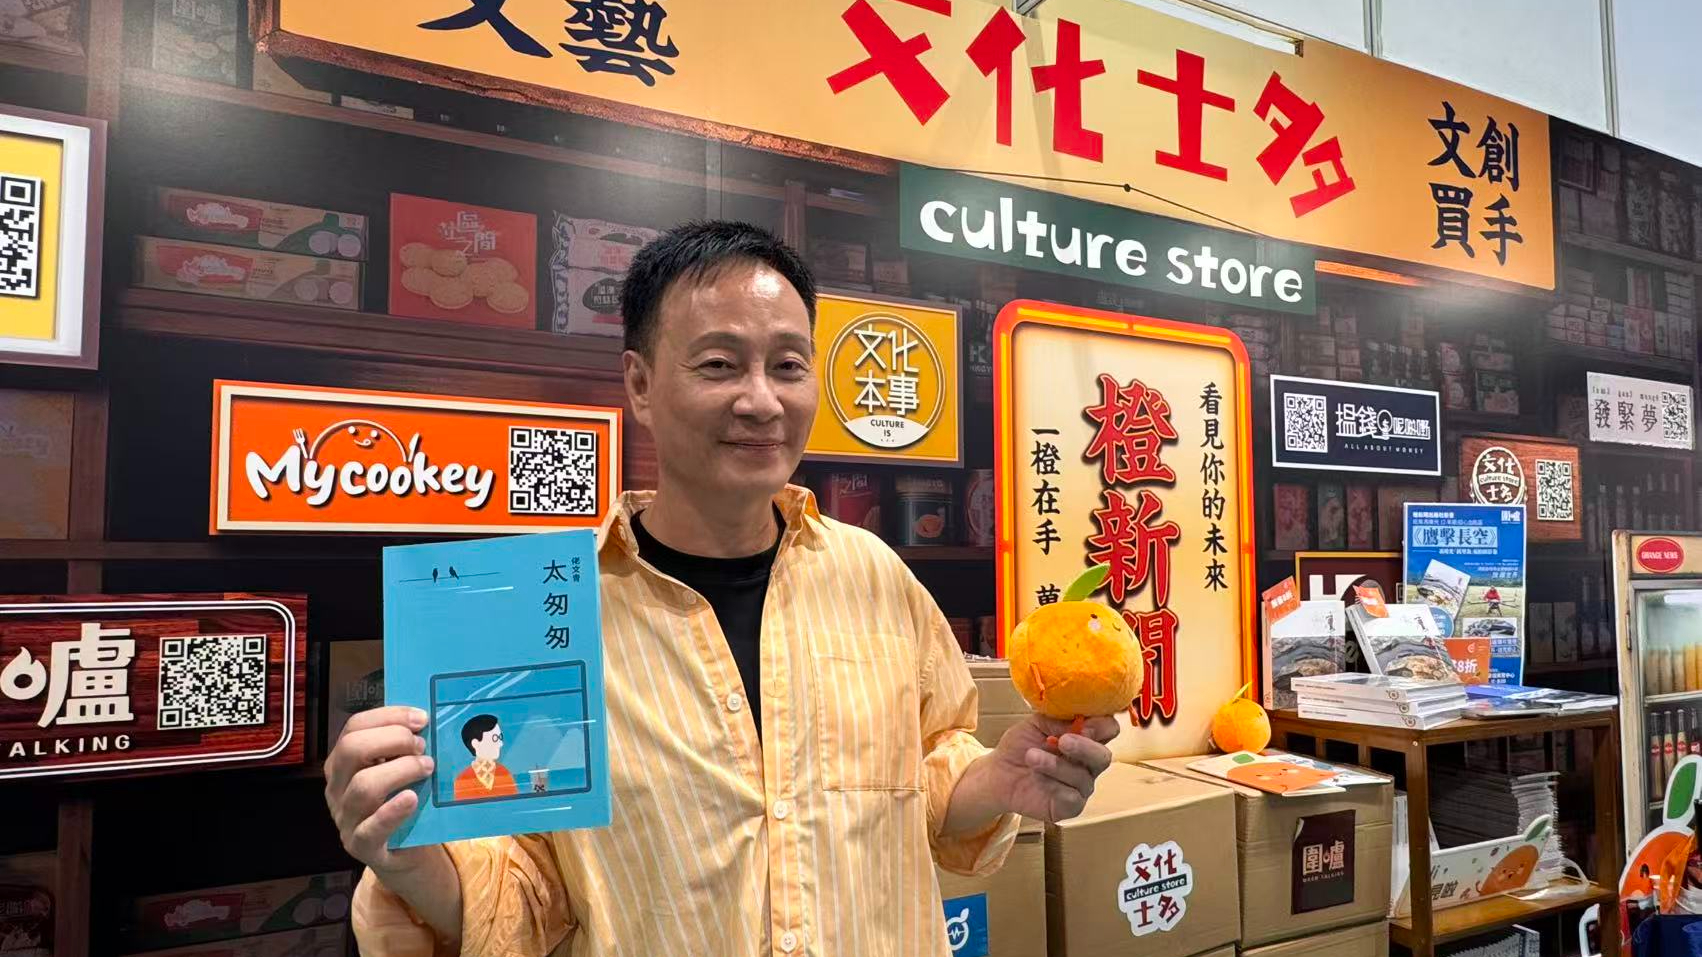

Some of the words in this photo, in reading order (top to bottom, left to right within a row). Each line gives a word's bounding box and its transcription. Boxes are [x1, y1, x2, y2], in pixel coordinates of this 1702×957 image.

[826, 0, 1356, 218] 文化士多
[920, 198, 1148, 276] culture
[1166, 246, 1303, 303] store
[854, 323, 919, 373] 文化
[854, 369, 920, 416] 本事
[870, 419, 905, 429] CULTURE
[1594, 398, 1658, 433] 發緊夢
[1344, 443, 1361, 451] ALL
[1364, 444, 1392, 452] ABOUT
[1482, 454, 1516, 475] 文化
[1031, 427, 1062, 556] 一橙在手
[1199, 382, 1229, 592] 看見你的未來
[1480, 475, 1502, 483] culture
[1502, 476, 1519, 485] store
[1486, 483, 1513, 502] 士多
[542, 558, 570, 650] 太匆匆
[0, 734, 132, 758] ALKING
[1132, 849, 1177, 884] 文化
[1126, 884, 1160, 900] culture
[1161, 878, 1185, 891] store
[1133, 894, 1180, 928] 士多
